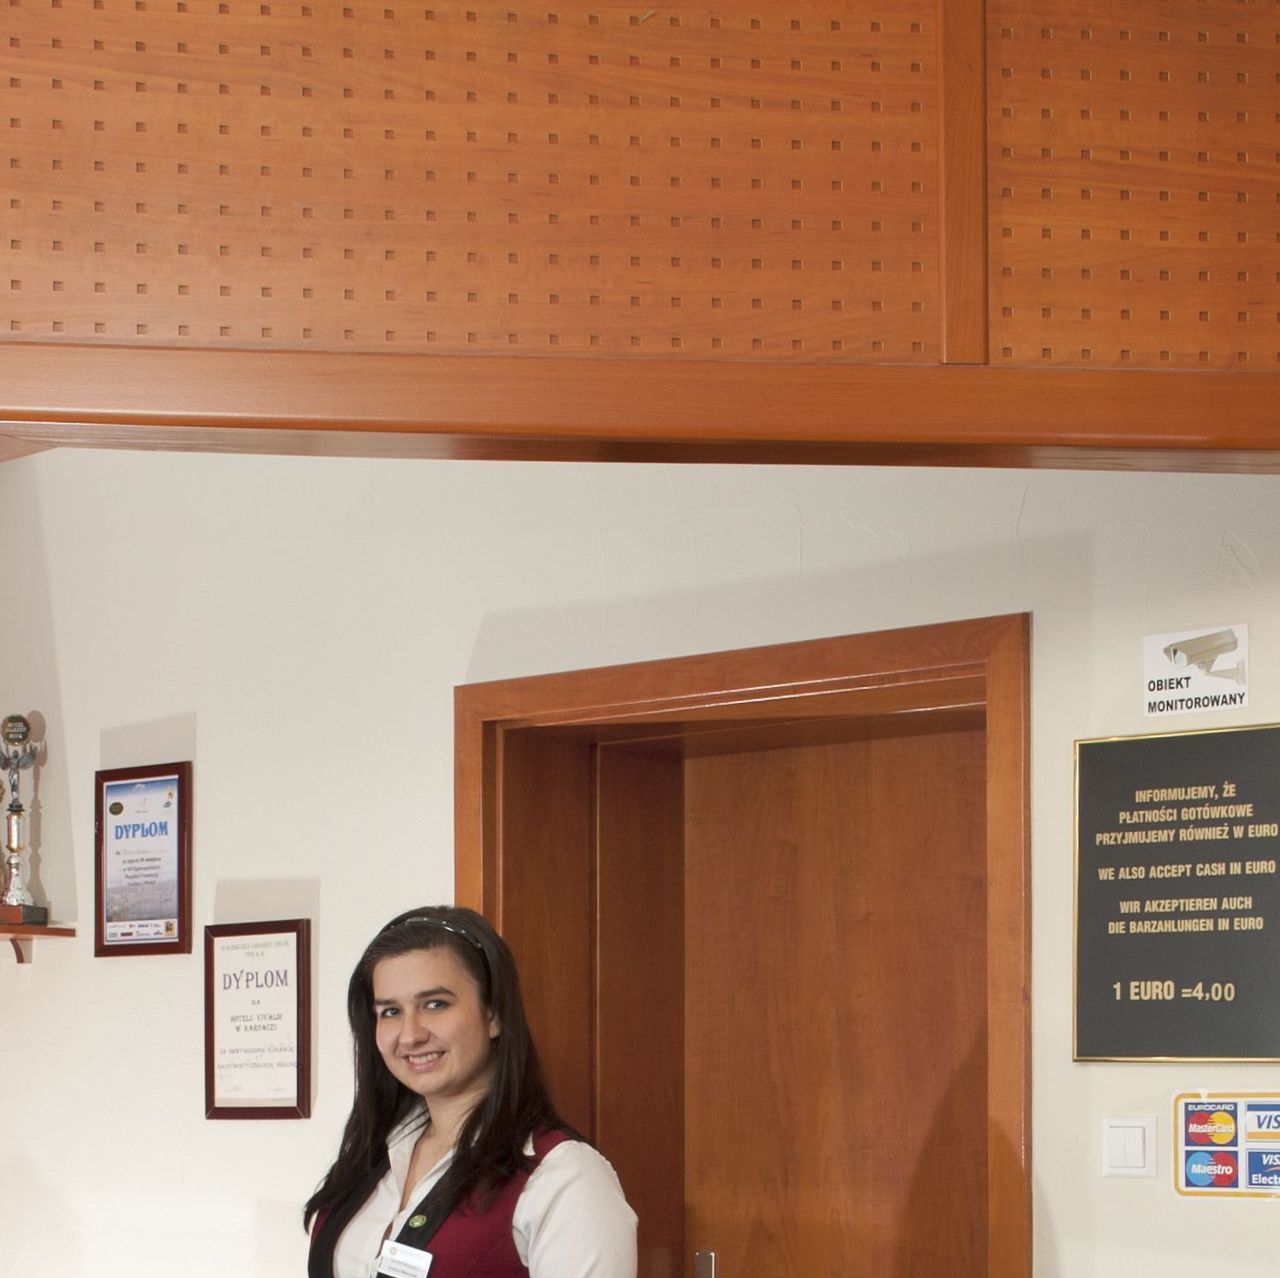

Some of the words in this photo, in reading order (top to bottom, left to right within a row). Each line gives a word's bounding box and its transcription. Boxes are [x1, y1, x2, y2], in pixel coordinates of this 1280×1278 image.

[1147, 676, 1192, 692] OBIEKT
[1147, 692, 1246, 713] MONITOROWANY
[1135, 785, 1219, 803] INFORMUJEMY,
[1222, 781, 1237, 798] ŻE
[1118, 806, 1178, 824] PŁATNOŚCI
[1180, 803, 1254, 822] GOTÓWKOWE
[114, 821, 169, 840] DYPLOM
[1095, 829, 1176, 846] PRZYJMUJEMY
[1179, 823, 1230, 842] RÓWNIEŻ
[1233, 826, 1244, 839] W
[1248, 823, 1279, 838] EURO
[1098, 868, 1115, 880] WE
[1118, 866, 1146, 880] ALSO
[1149, 864, 1193, 879] ACCEPT
[1196, 862, 1226, 877] CASH
[1229, 862, 1242, 875] IN
[1245, 860, 1277, 875] EURO
[1119, 900, 1141, 914] WIR
[1144, 898, 1218, 913] AKZEPTIEREN
[1221, 896, 1253, 911] AUCH
[1108, 921, 1126, 935] DIE
[1129, 919, 1214, 934] BARZAHLUNGEN
[1218, 918, 1230, 931] IN
[1233, 917, 1264, 931] EURO
[222, 969, 289, 991] DYPLOM
[1113, 982, 1121, 1000] 1
[1129, 980, 1175, 1001] EURO
[1181, 981, 1236, 1001] =4,00
[1187, 1104, 1235, 1112] EUROCARD
[1187, 1123, 1234, 1134] MasterCard
[1191, 1163, 1233, 1176] Maestro
